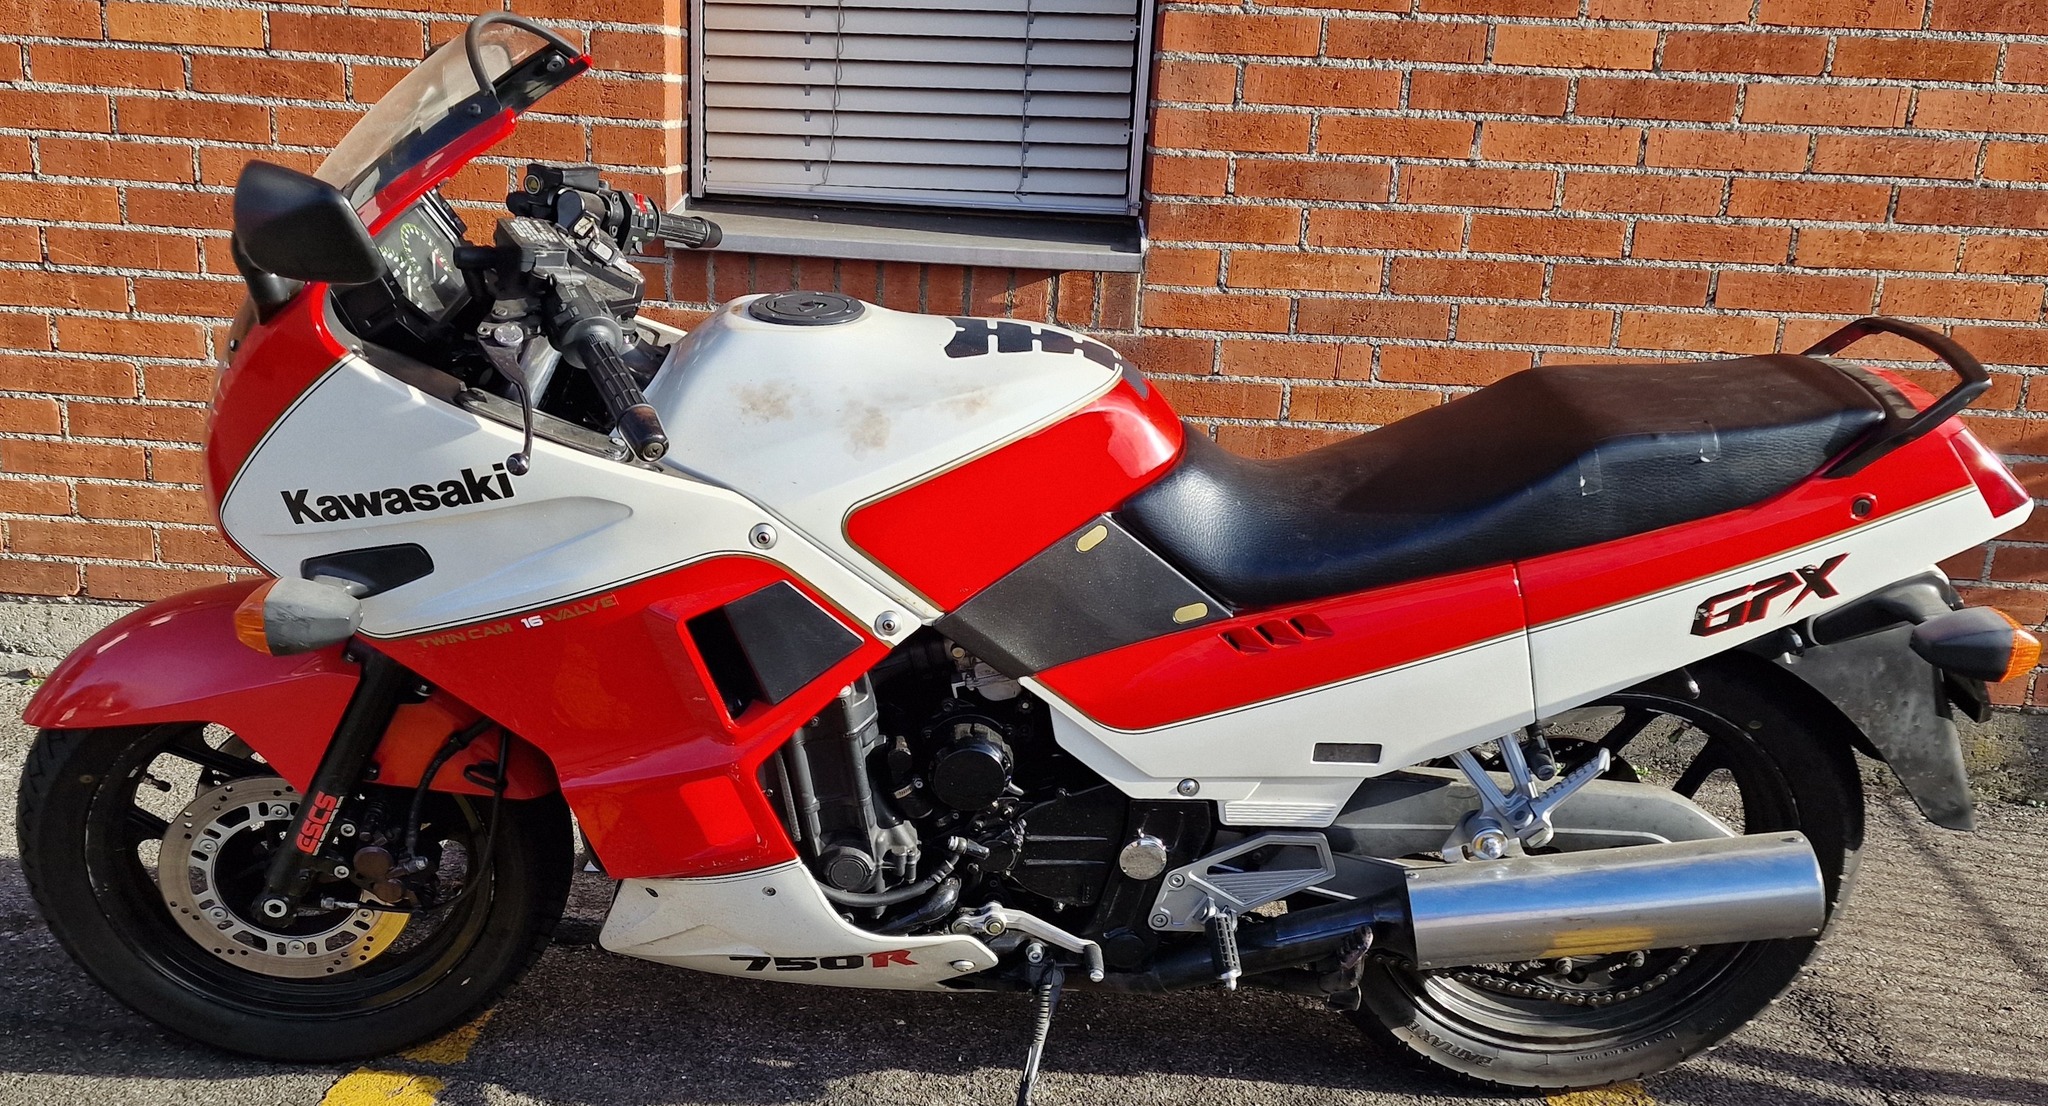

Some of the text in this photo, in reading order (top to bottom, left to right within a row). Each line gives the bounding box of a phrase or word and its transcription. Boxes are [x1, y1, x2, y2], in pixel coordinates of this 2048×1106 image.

[280, 462, 515, 525] Kawasaki
[1690, 552, 1850, 637] GPX
[416, 632, 466, 649] TWIN
[468, 622, 514, 640] CAM
[729, 949, 919, 972] 750R
